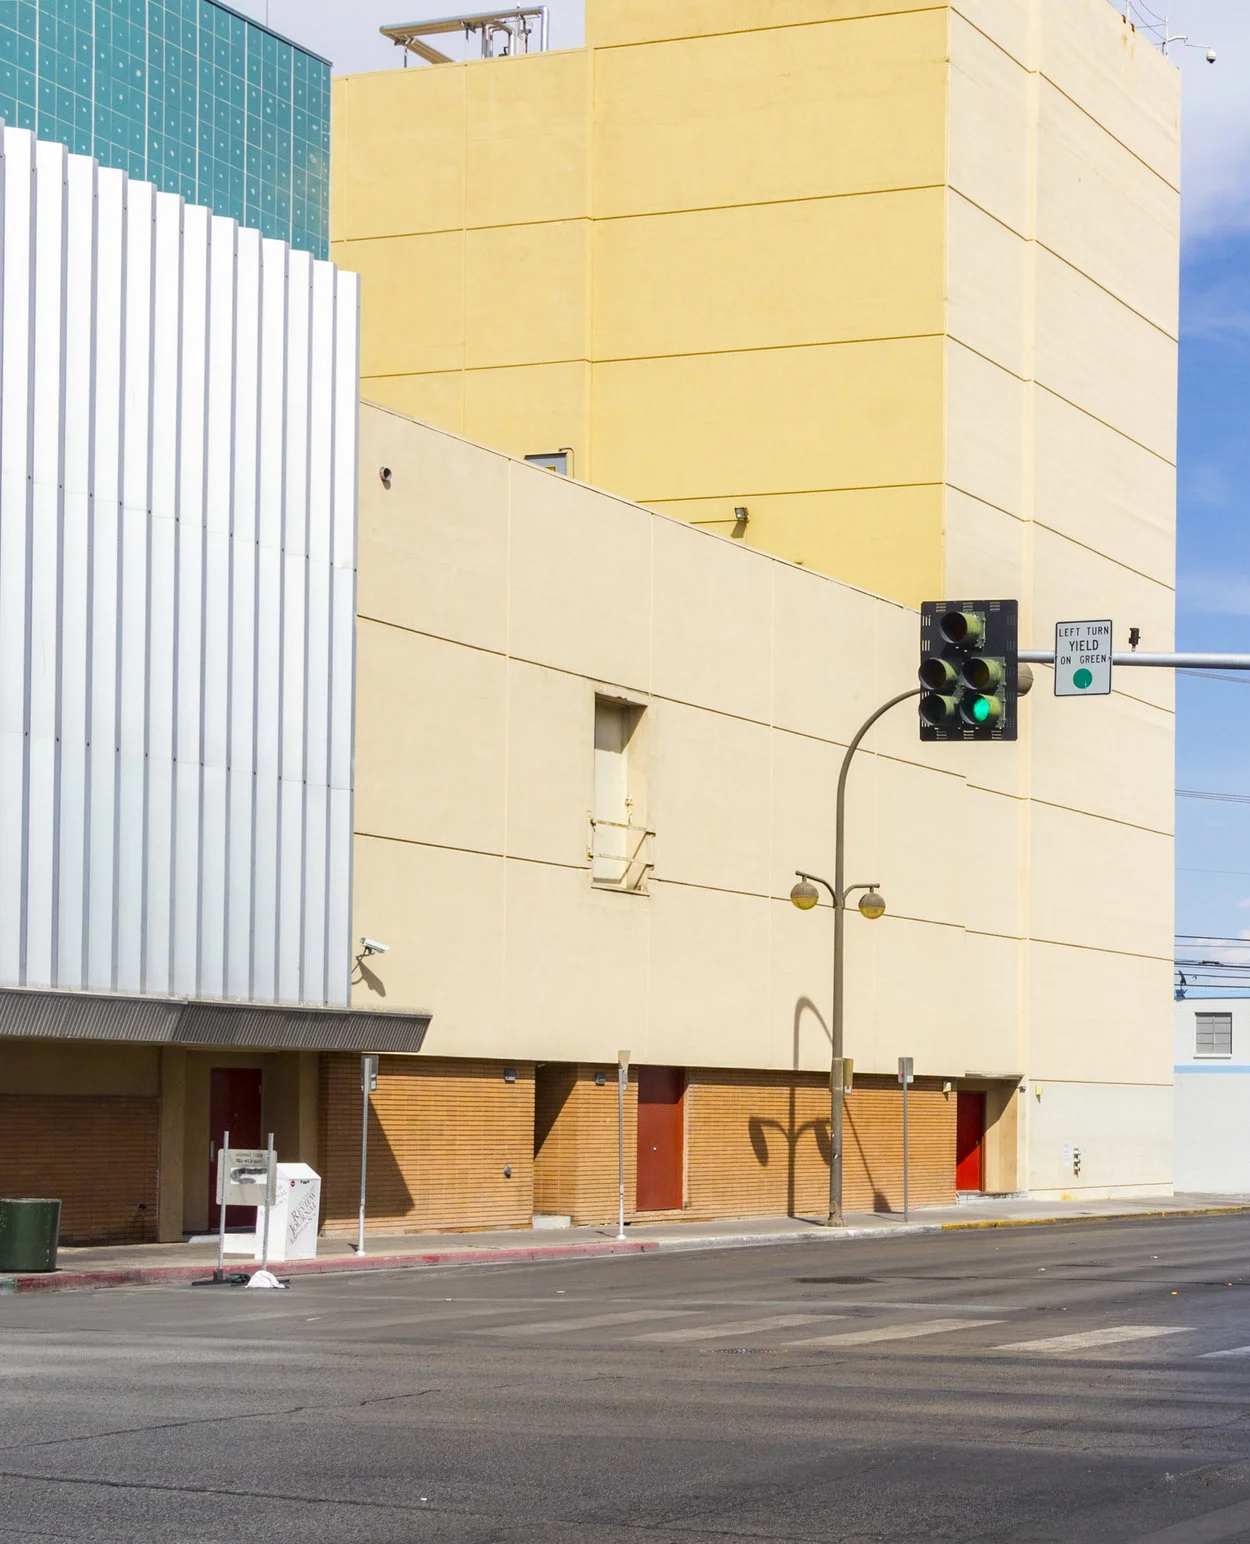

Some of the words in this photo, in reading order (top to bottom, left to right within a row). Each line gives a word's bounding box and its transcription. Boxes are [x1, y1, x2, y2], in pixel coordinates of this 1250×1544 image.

[1059, 627, 1080, 638] LEFT
[1086, 626, 1109, 636] TURN
[1069, 639, 1099, 652] YIELD
[1060, 655, 1072, 666] ON
[1079, 654, 1107, 665] GREEN
